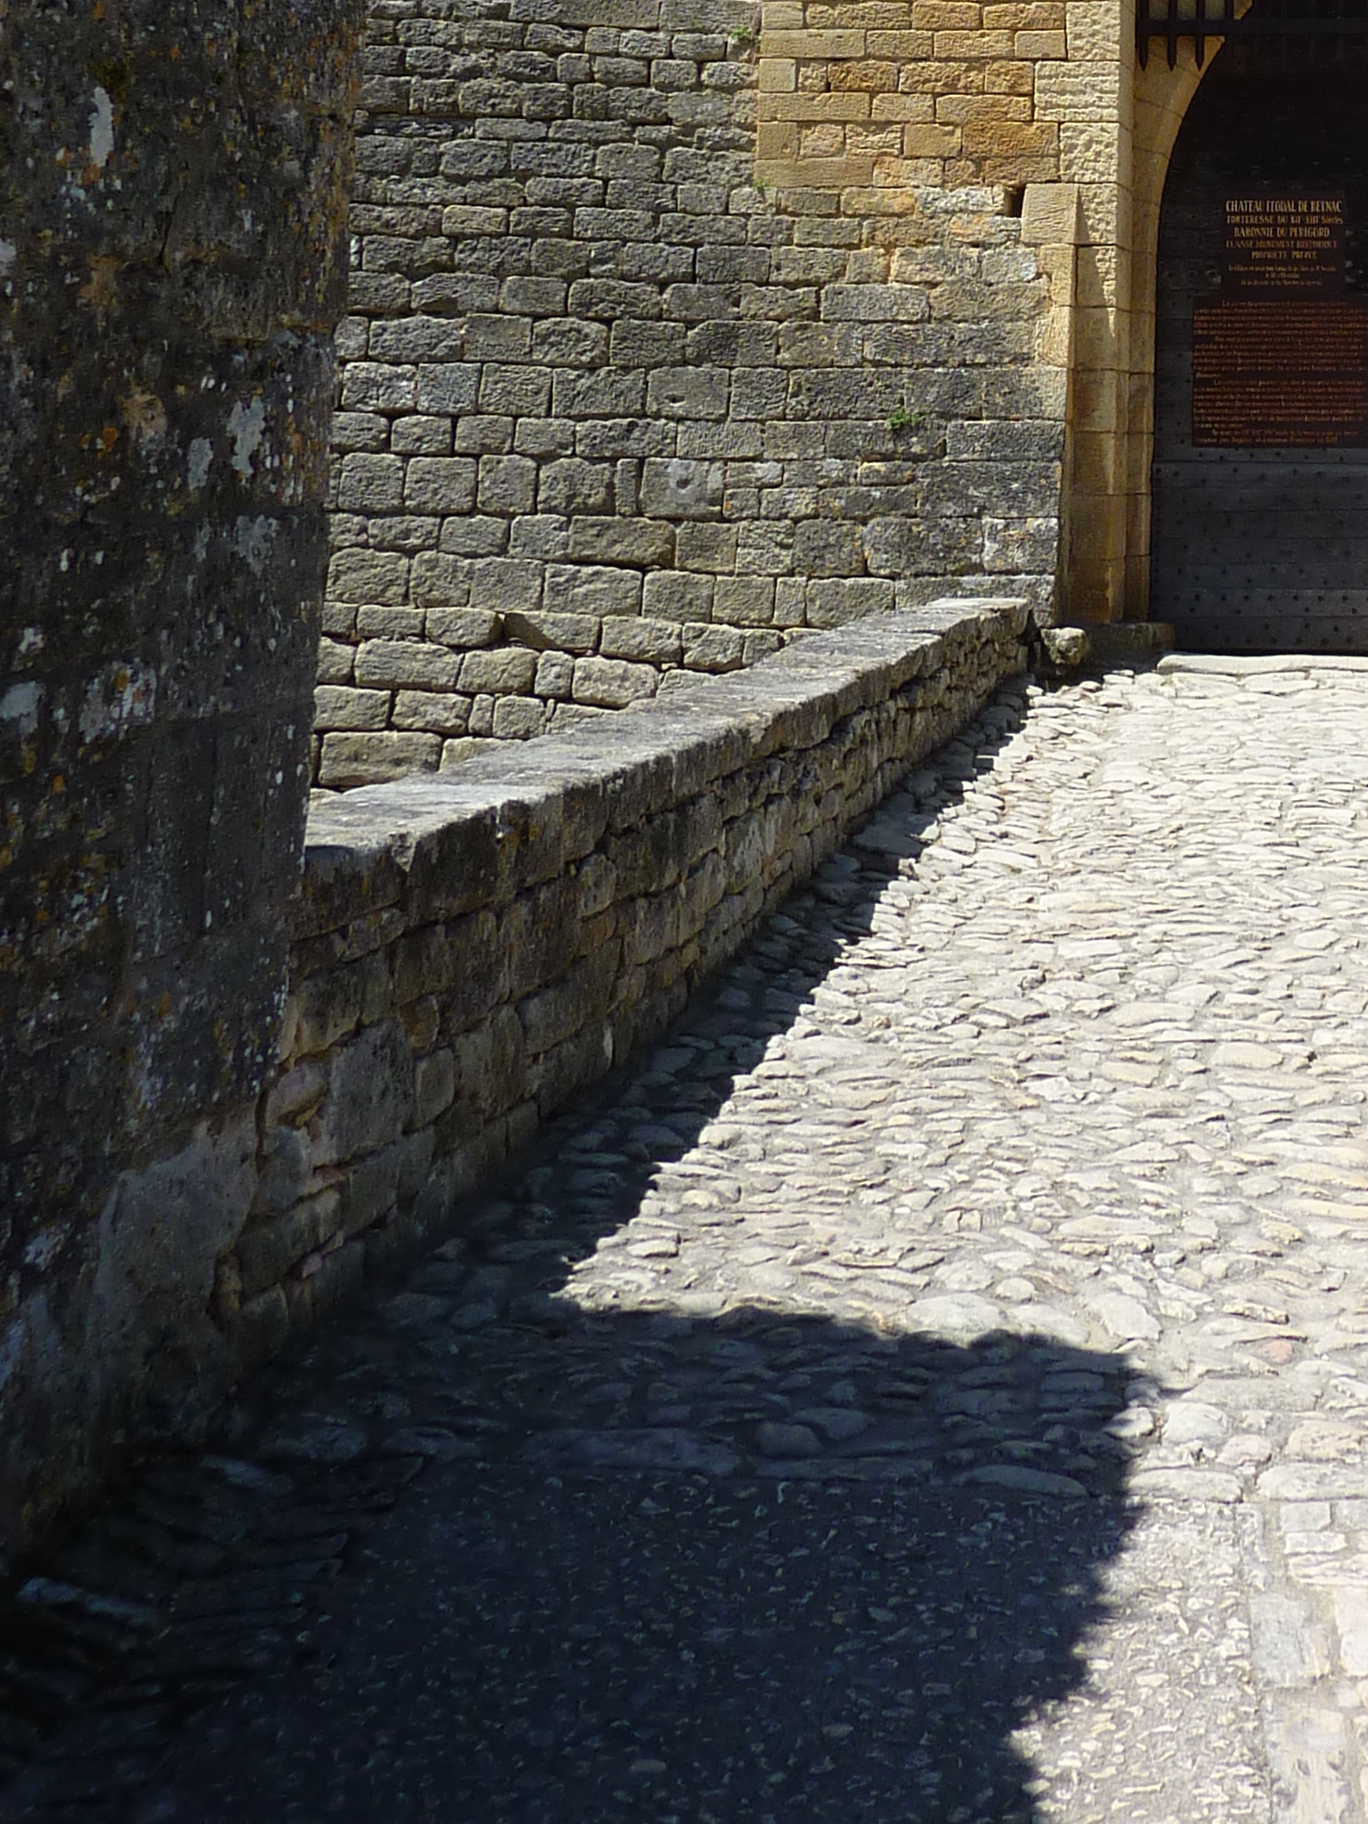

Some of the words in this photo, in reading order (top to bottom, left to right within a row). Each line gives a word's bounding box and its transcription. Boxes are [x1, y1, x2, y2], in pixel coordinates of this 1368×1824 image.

[1298, 200, 1309, 212] DE
[1277, 215, 1288, 224] DU
[1276, 227, 1288, 237] DU
